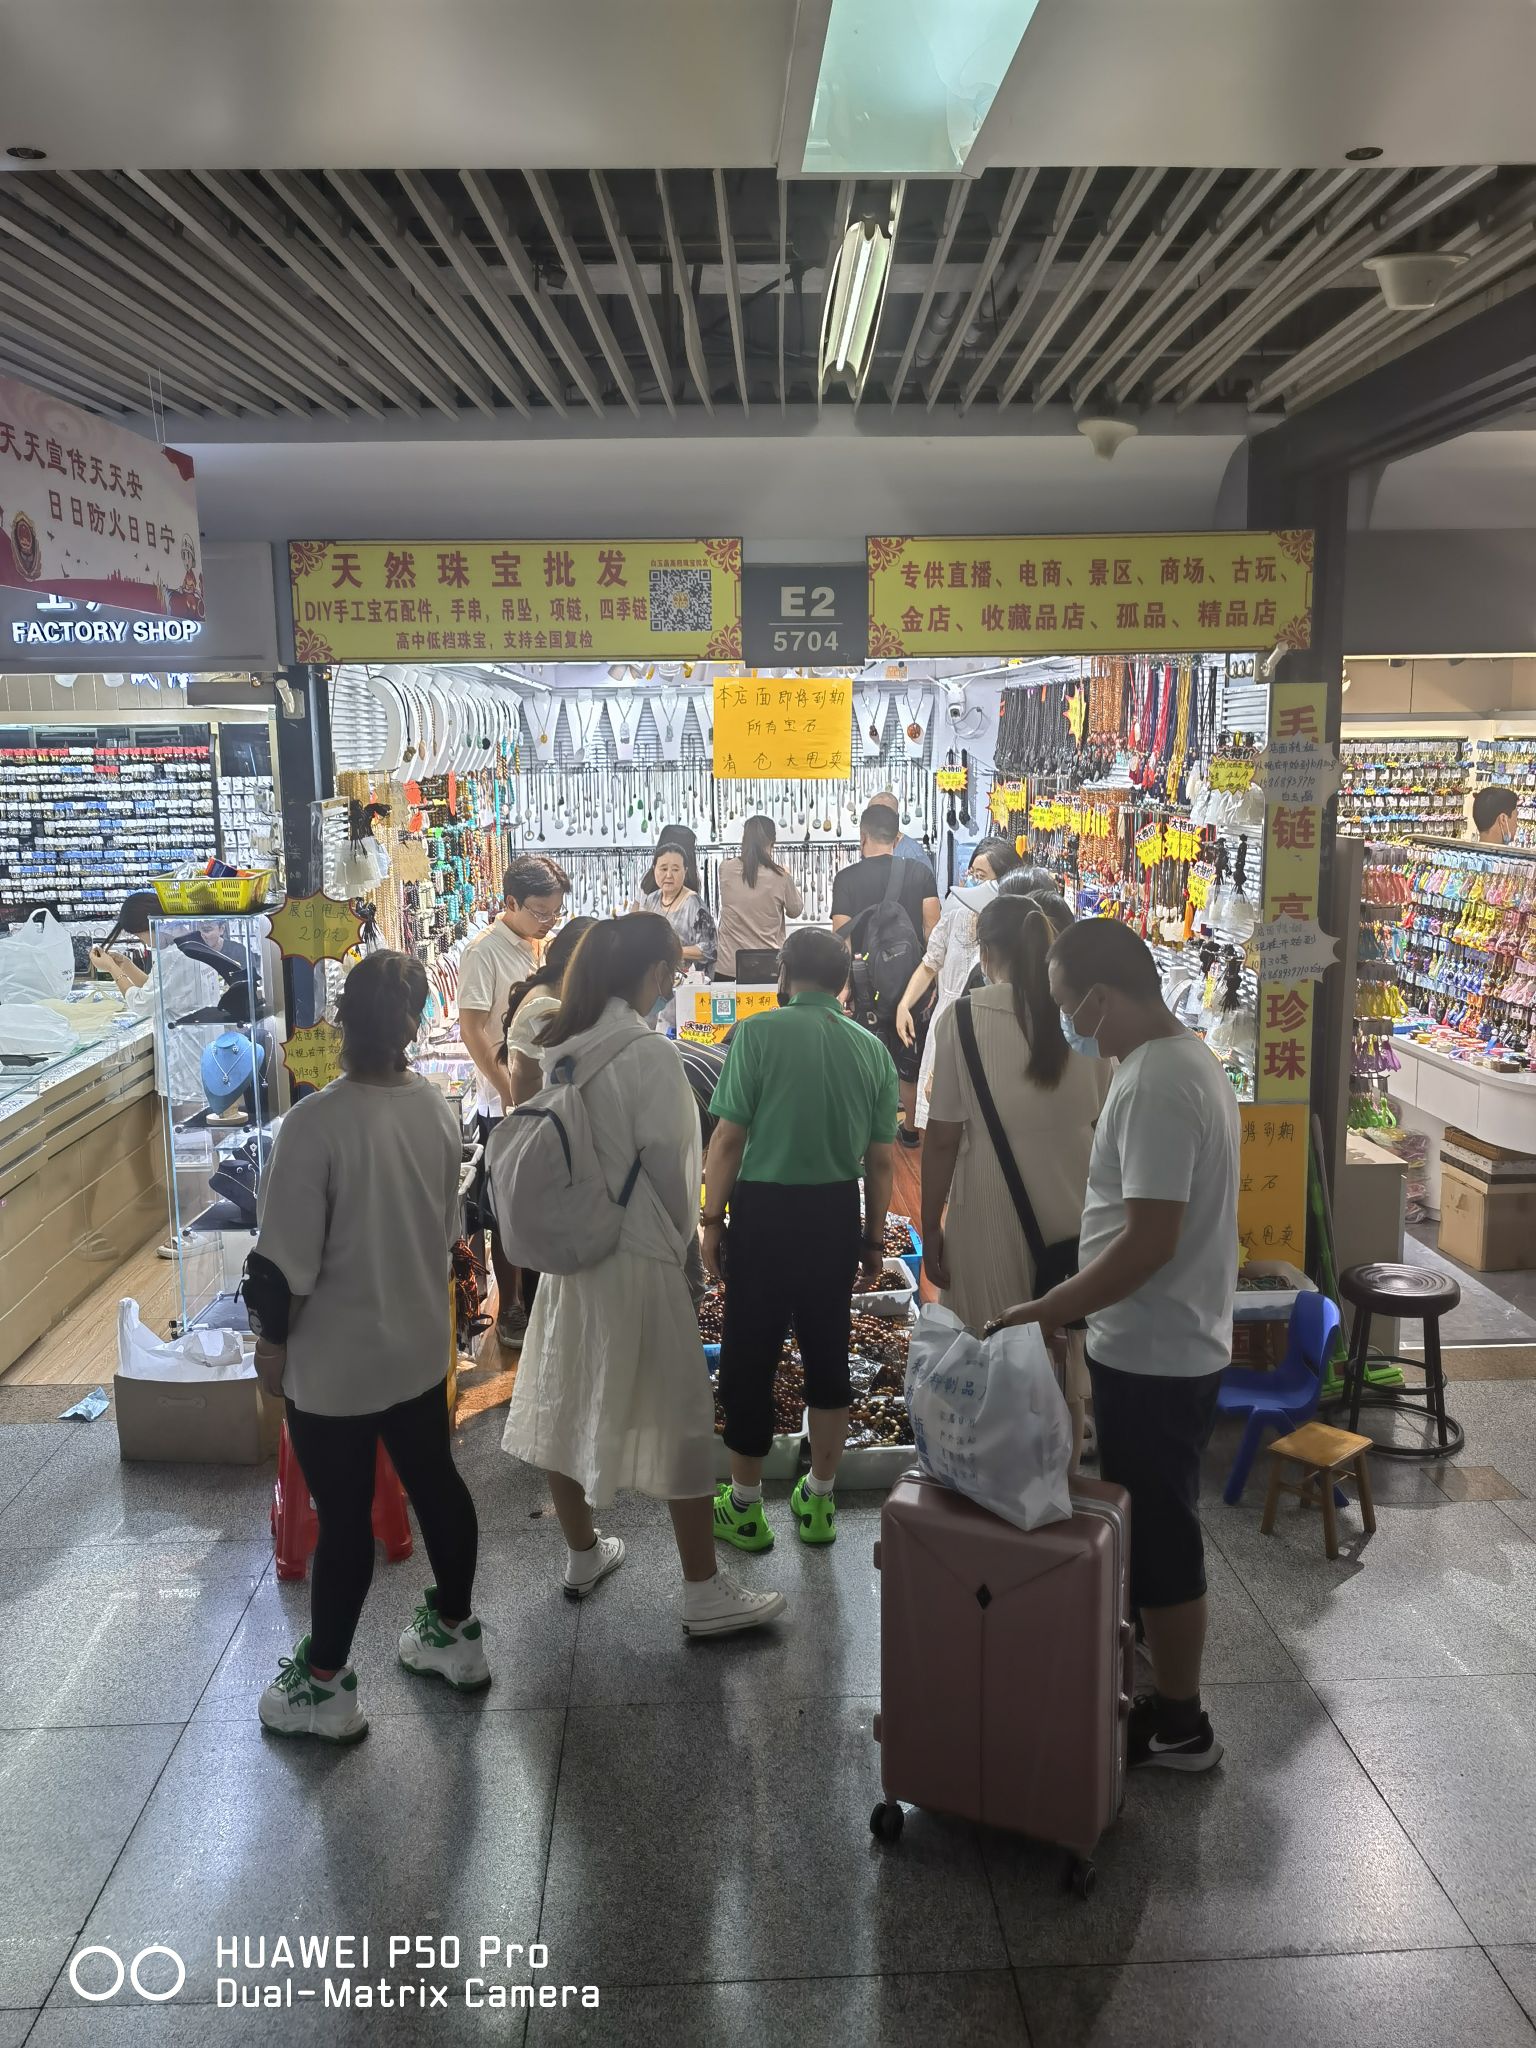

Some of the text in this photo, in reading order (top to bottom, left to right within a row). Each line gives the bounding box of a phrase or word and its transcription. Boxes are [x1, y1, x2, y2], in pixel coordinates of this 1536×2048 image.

[0, 421, 143, 501] 天天宣传天天安
[48, 489, 175, 554] 日日防火日日宁
[331, 550, 628, 589] 天然珠宝批发
[900, 555, 1287, 589] 专供直播、电商、景区、商场、古玩、
[780, 586, 835, 617] E2
[900, 599, 1277, 633] 金店、收藏品店、孤品、精品店
[12, 620, 201, 643] FACTORY SHOP
[396, 630, 593, 650] 高中低档珠宝，支持全国复检
[773, 631, 838, 652] 5704
[716, 684, 845, 711] 本店面即将到期
[746, 719, 817, 736] 所有宝石
[722, 750, 843, 774] 清仓大甩卖
